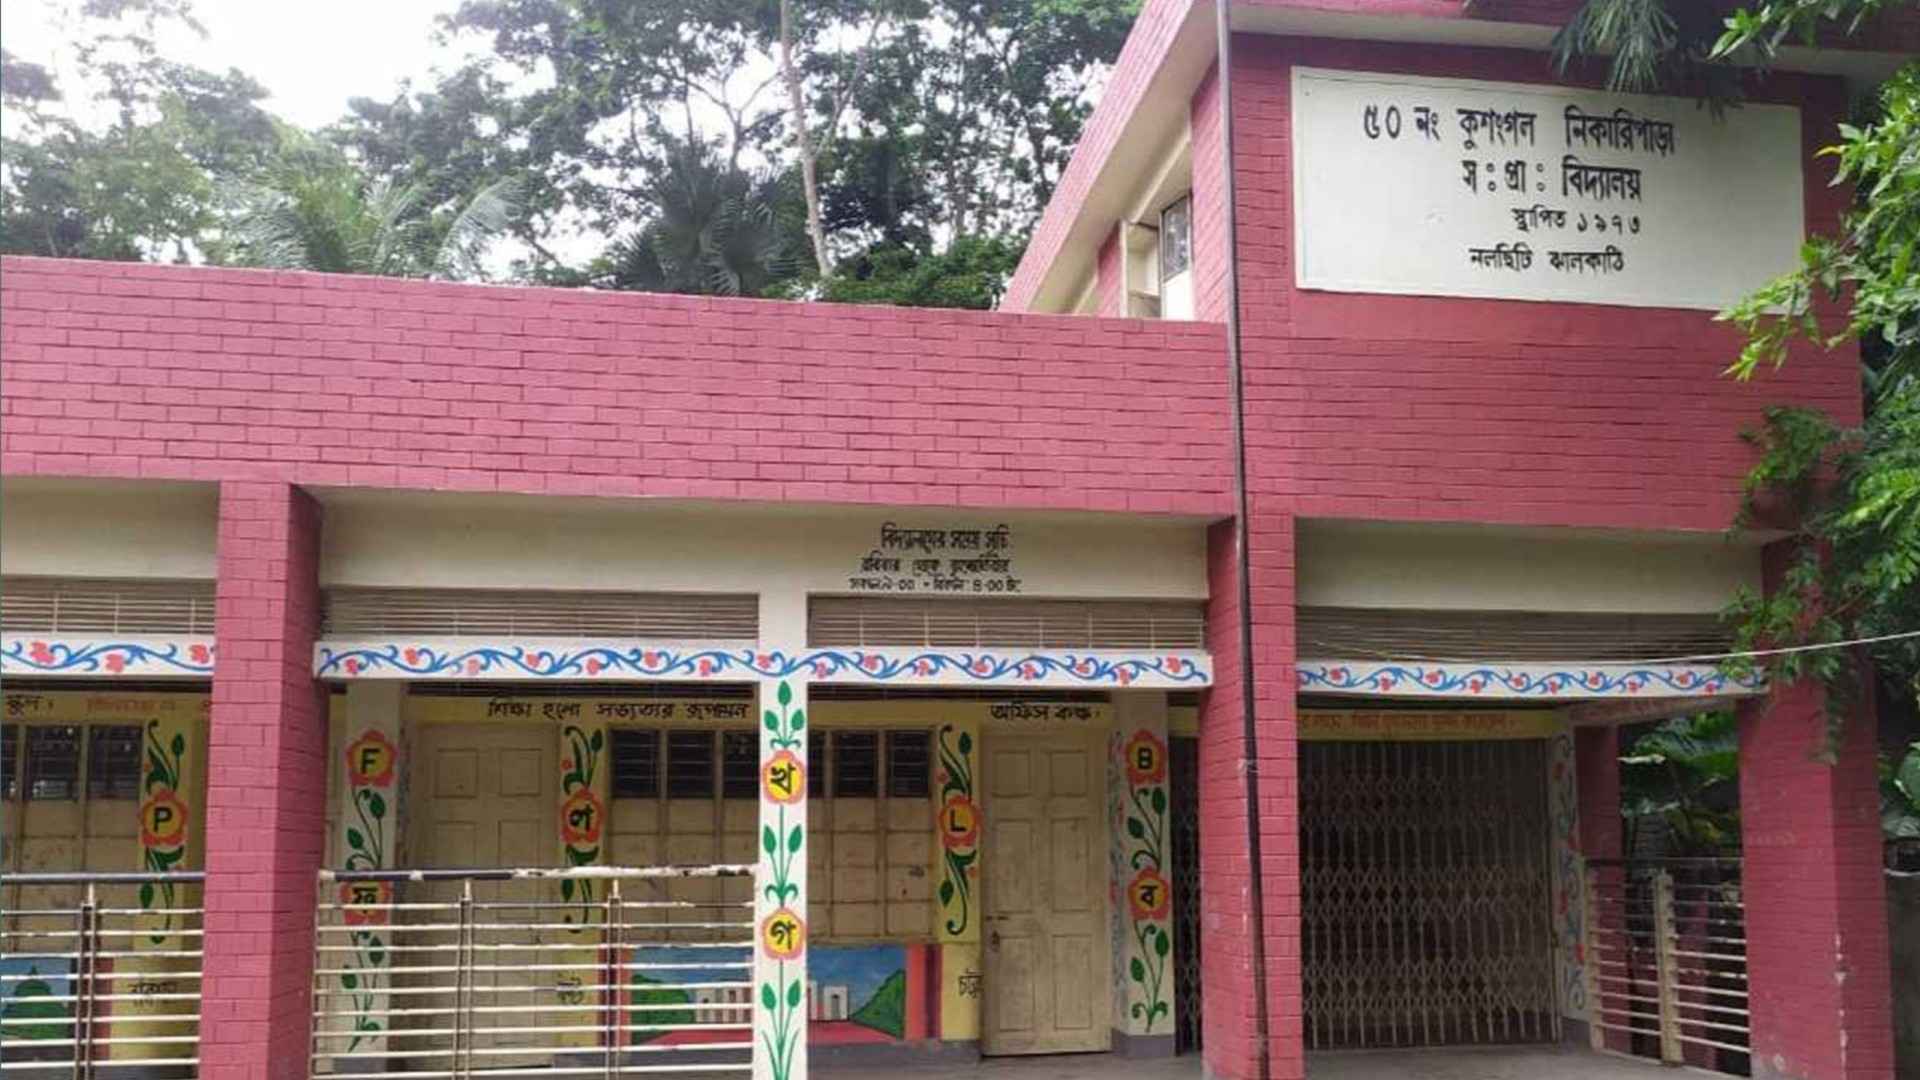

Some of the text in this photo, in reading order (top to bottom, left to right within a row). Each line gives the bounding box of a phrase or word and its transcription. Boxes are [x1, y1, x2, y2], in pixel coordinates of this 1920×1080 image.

[1562, 154, 1642, 201] বিদ্যালয়
[1548, 245, 1625, 275] ঝালকাঠি
[360, 749, 380, 775] F
[1136, 747, 1154, 770] B
[153, 806, 174, 833] P
[949, 810, 968, 832] L
[769, 919, 796, 950] গ
